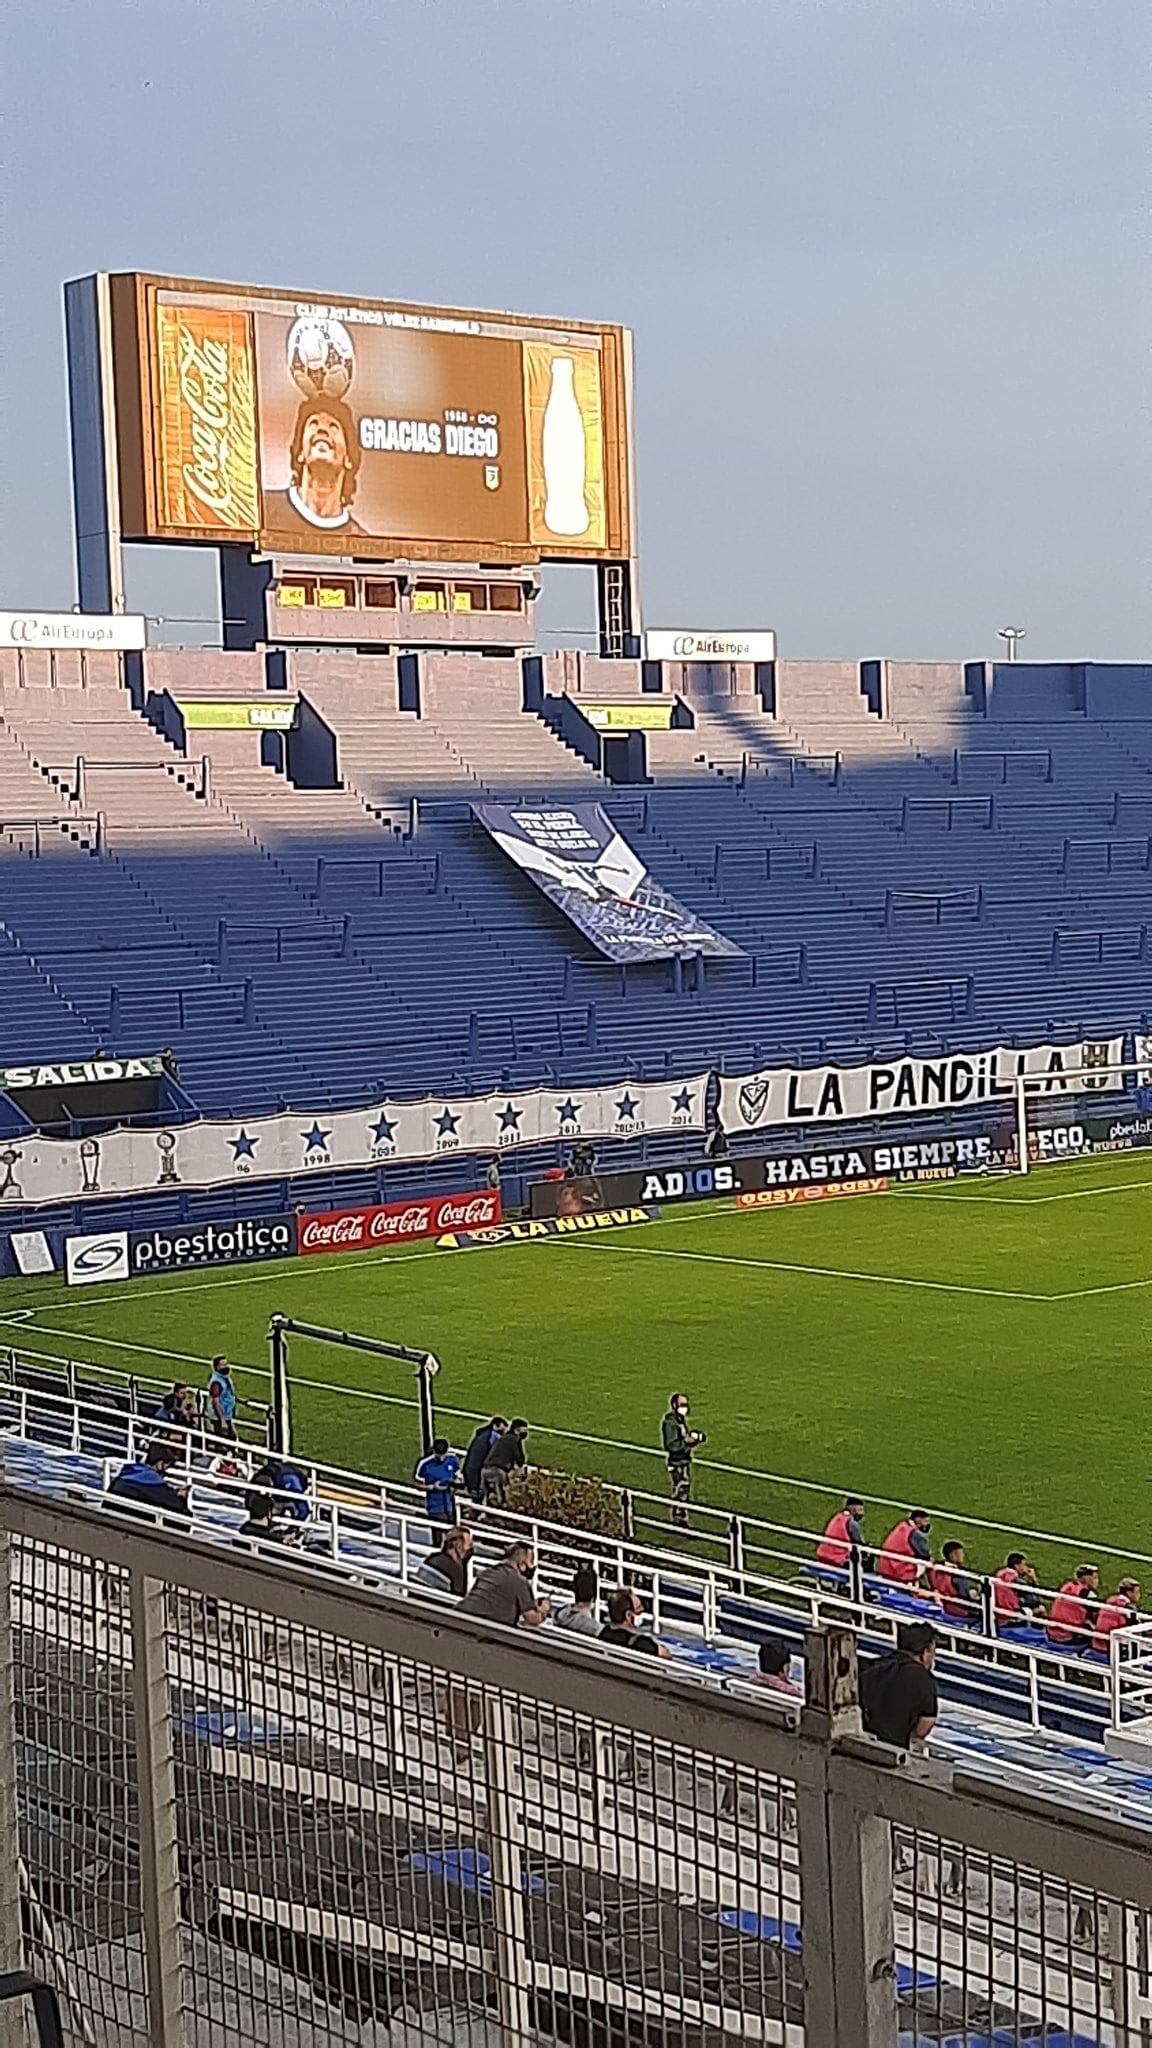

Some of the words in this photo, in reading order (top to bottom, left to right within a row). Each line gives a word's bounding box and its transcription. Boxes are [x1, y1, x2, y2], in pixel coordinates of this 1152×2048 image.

[360, 417, 441, 454] GRACIAS
[445, 424, 499, 458] DIEGO
[4, 1060, 151, 1088] SALIDA
[788, 1073, 843, 1117] LA
[303, 1155, 331, 1167] 1998
[371, 1145, 397, 1159] 2005
[766, 1153, 867, 1184] HASTA
[900, 1170, 914, 1182] LA
[917, 1167, 956, 1180] NUEVA
[741, 1188, 799, 1205] easy
[827, 1178, 884, 1194] easy
[511, 1220, 550, 1238] LA
[556, 1207, 650, 1233] NUEVA
[143, 1245, 289, 1269] INTERNACIONAL
